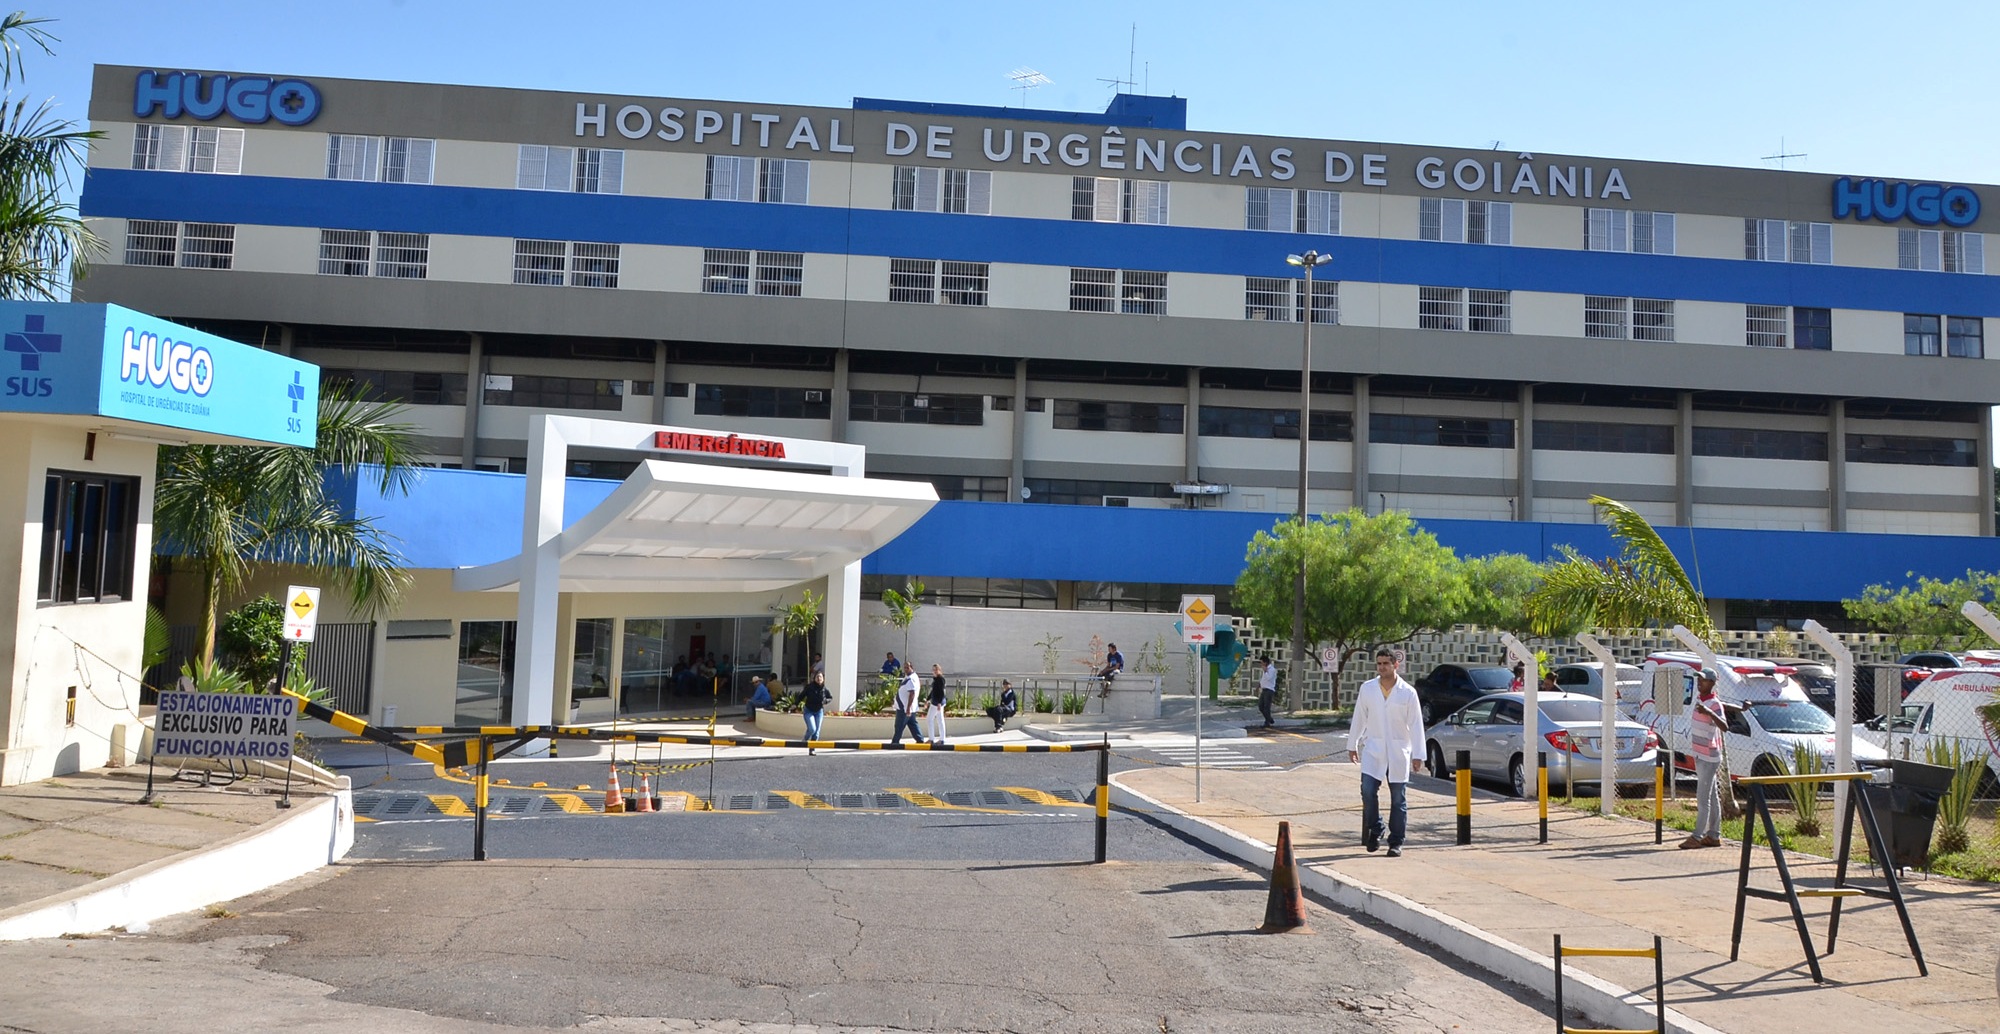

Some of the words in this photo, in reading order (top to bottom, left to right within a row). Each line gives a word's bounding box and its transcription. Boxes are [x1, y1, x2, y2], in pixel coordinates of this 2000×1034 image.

[134, 70, 322, 126] HUGO
[575, 103, 854, 153] HOSPITAL
[885, 122, 953, 160] DE
[983, 126, 1296, 181] URGÊNCIAS
[1324, 150, 1388, 187] DE
[1415, 151, 1632, 200] GOIÂNIA
[1832, 176, 1980, 227] HUGO
[120, 327, 214, 397] HUGO
[6, 376, 53, 397] SUS
[120, 391, 147, 406] HOSPITAL
[287, 417, 302, 434] SUS
[654, 431, 786, 458] EMERGÊNCIA
[159, 693, 293, 717] ESTACIONAMENTO
[161, 713, 243, 735] EXCLUSIVO
[251, 717, 288, 736] PARA
[155, 738, 290, 758] FUNCIONÁRIOS
